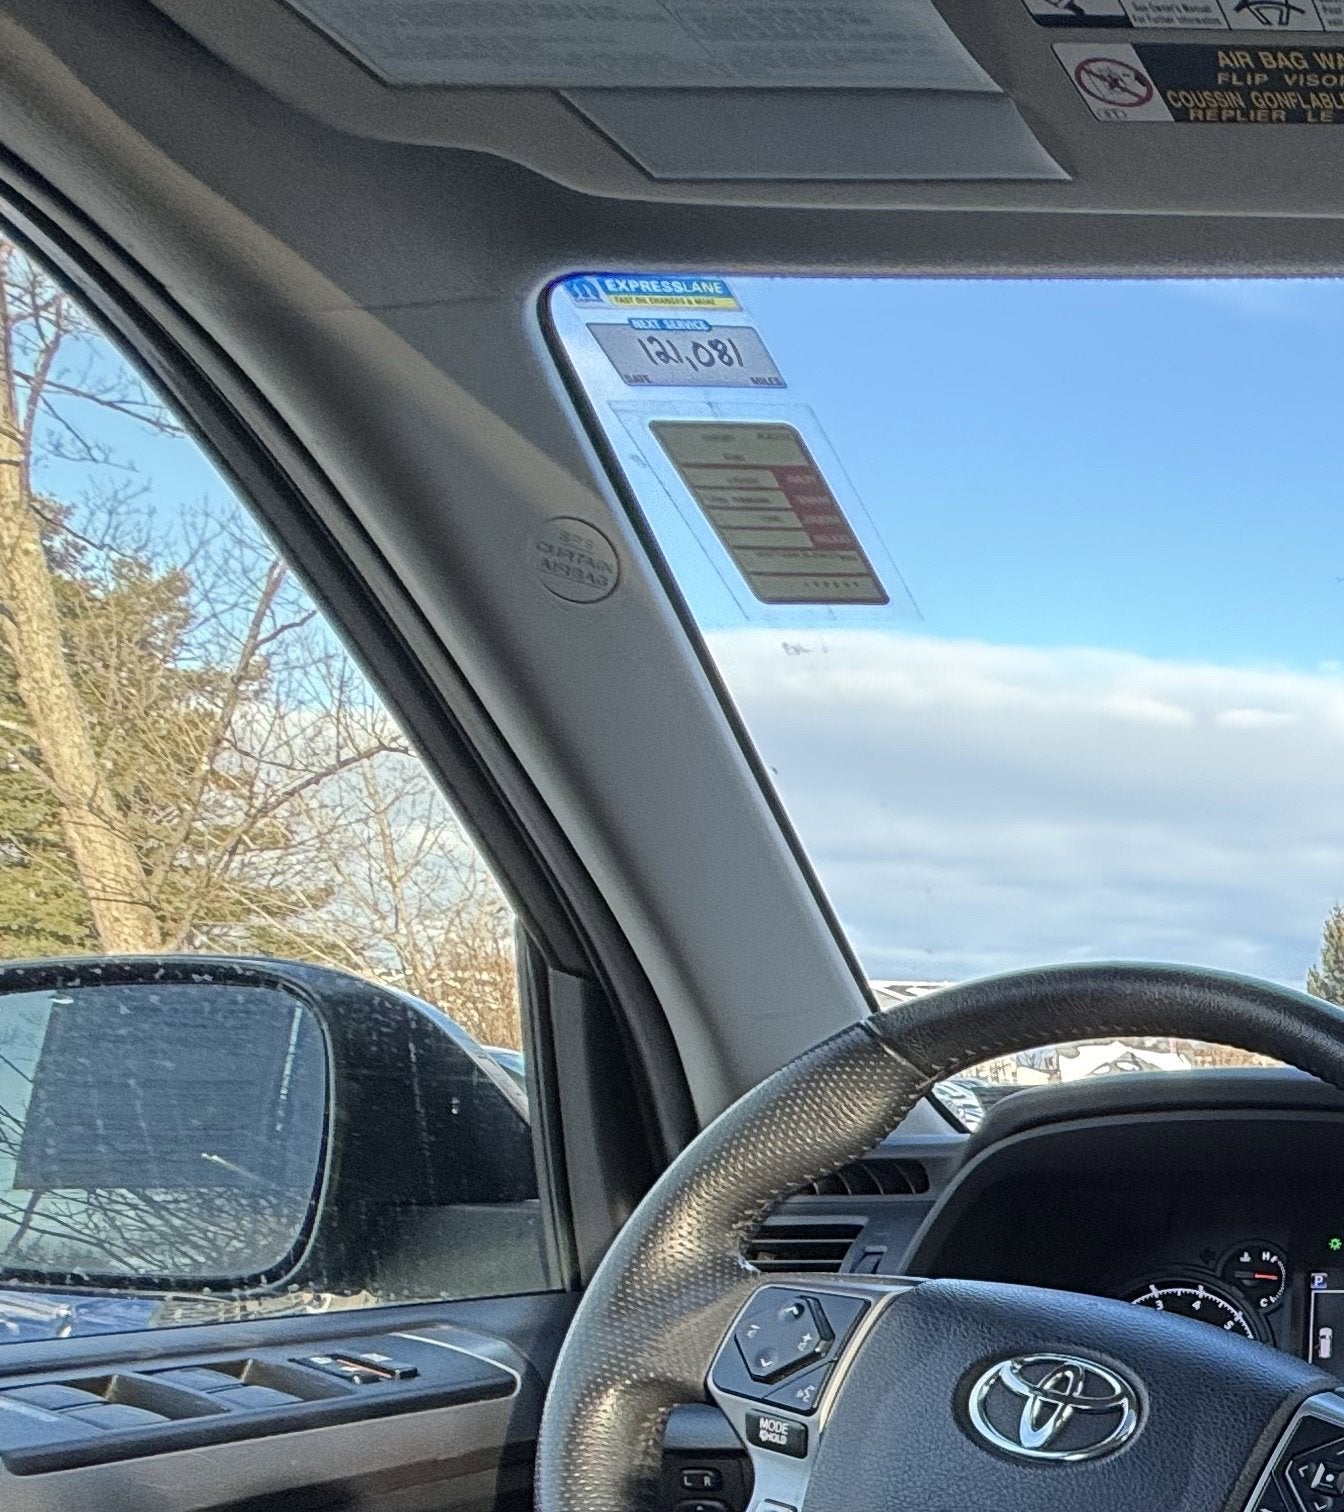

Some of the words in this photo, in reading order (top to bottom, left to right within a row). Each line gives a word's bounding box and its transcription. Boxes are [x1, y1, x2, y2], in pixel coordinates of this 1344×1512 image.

[1217, 51, 1254, 68] AIR
[1258, 51, 1309, 70] BAG
[1217, 73, 1268, 86] FLIP
[1166, 91, 1245, 109] COUSSIN
[1190, 109, 1286, 122] REPLIER
[1308, 110, 1333, 123] LE
[638, 336, 743, 372] 121,081
[1262, 1251, 1271, 1261] H
[1155, 1300, 1164, 1311] 3
[1192, 1300, 1201, 1311] 4
[1260, 1298, 1268, 1307] C
[1224, 1320, 1235, 1331] 5
[760, 1417, 789, 1436] MODE
[683, 1476, 693, 1487] L
[703, 1476, 712, 1487] R
